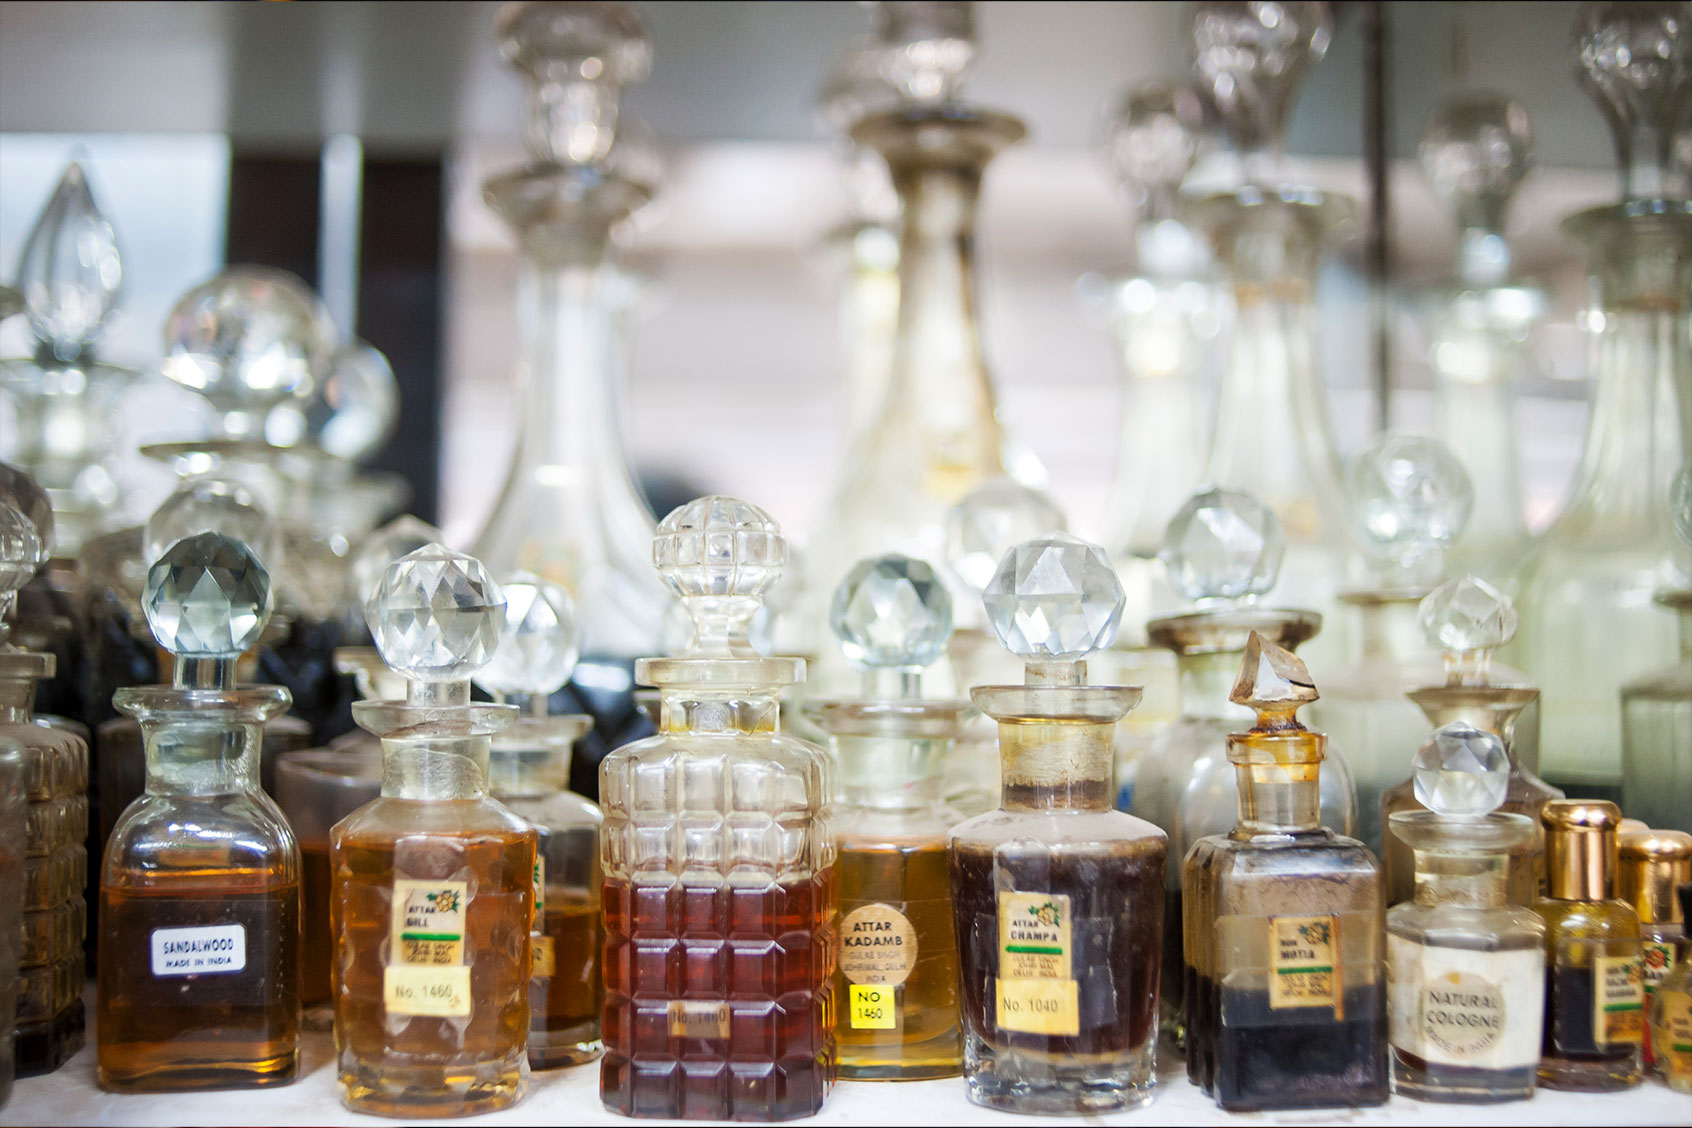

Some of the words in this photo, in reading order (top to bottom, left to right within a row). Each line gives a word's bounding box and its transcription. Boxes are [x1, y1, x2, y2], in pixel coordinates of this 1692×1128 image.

[853, 921, 892, 932] ATTAR
[1012, 919, 1039, 928] ATTAR
[844, 936, 903, 947] KADAMB
[1011, 930, 1058, 942] CHAMPA
[163, 938, 234, 955] SANDALWOOD
[166, 959, 191, 968] MADE
[194, 958, 205, 967] IN
[208, 956, 232, 966] INDIA
[395, 984, 418, 999] No.
[423, 984, 453, 999] 1460
[858, 991, 881, 1003] NO
[1003, 997, 1024, 1011] No.
[1029, 998, 1059, 1013] 1040
[1429, 990, 1498, 1009] NATURAL
[858, 1008, 883, 1020] 1460
[1426, 1010, 1501, 1029] COLOGNE
